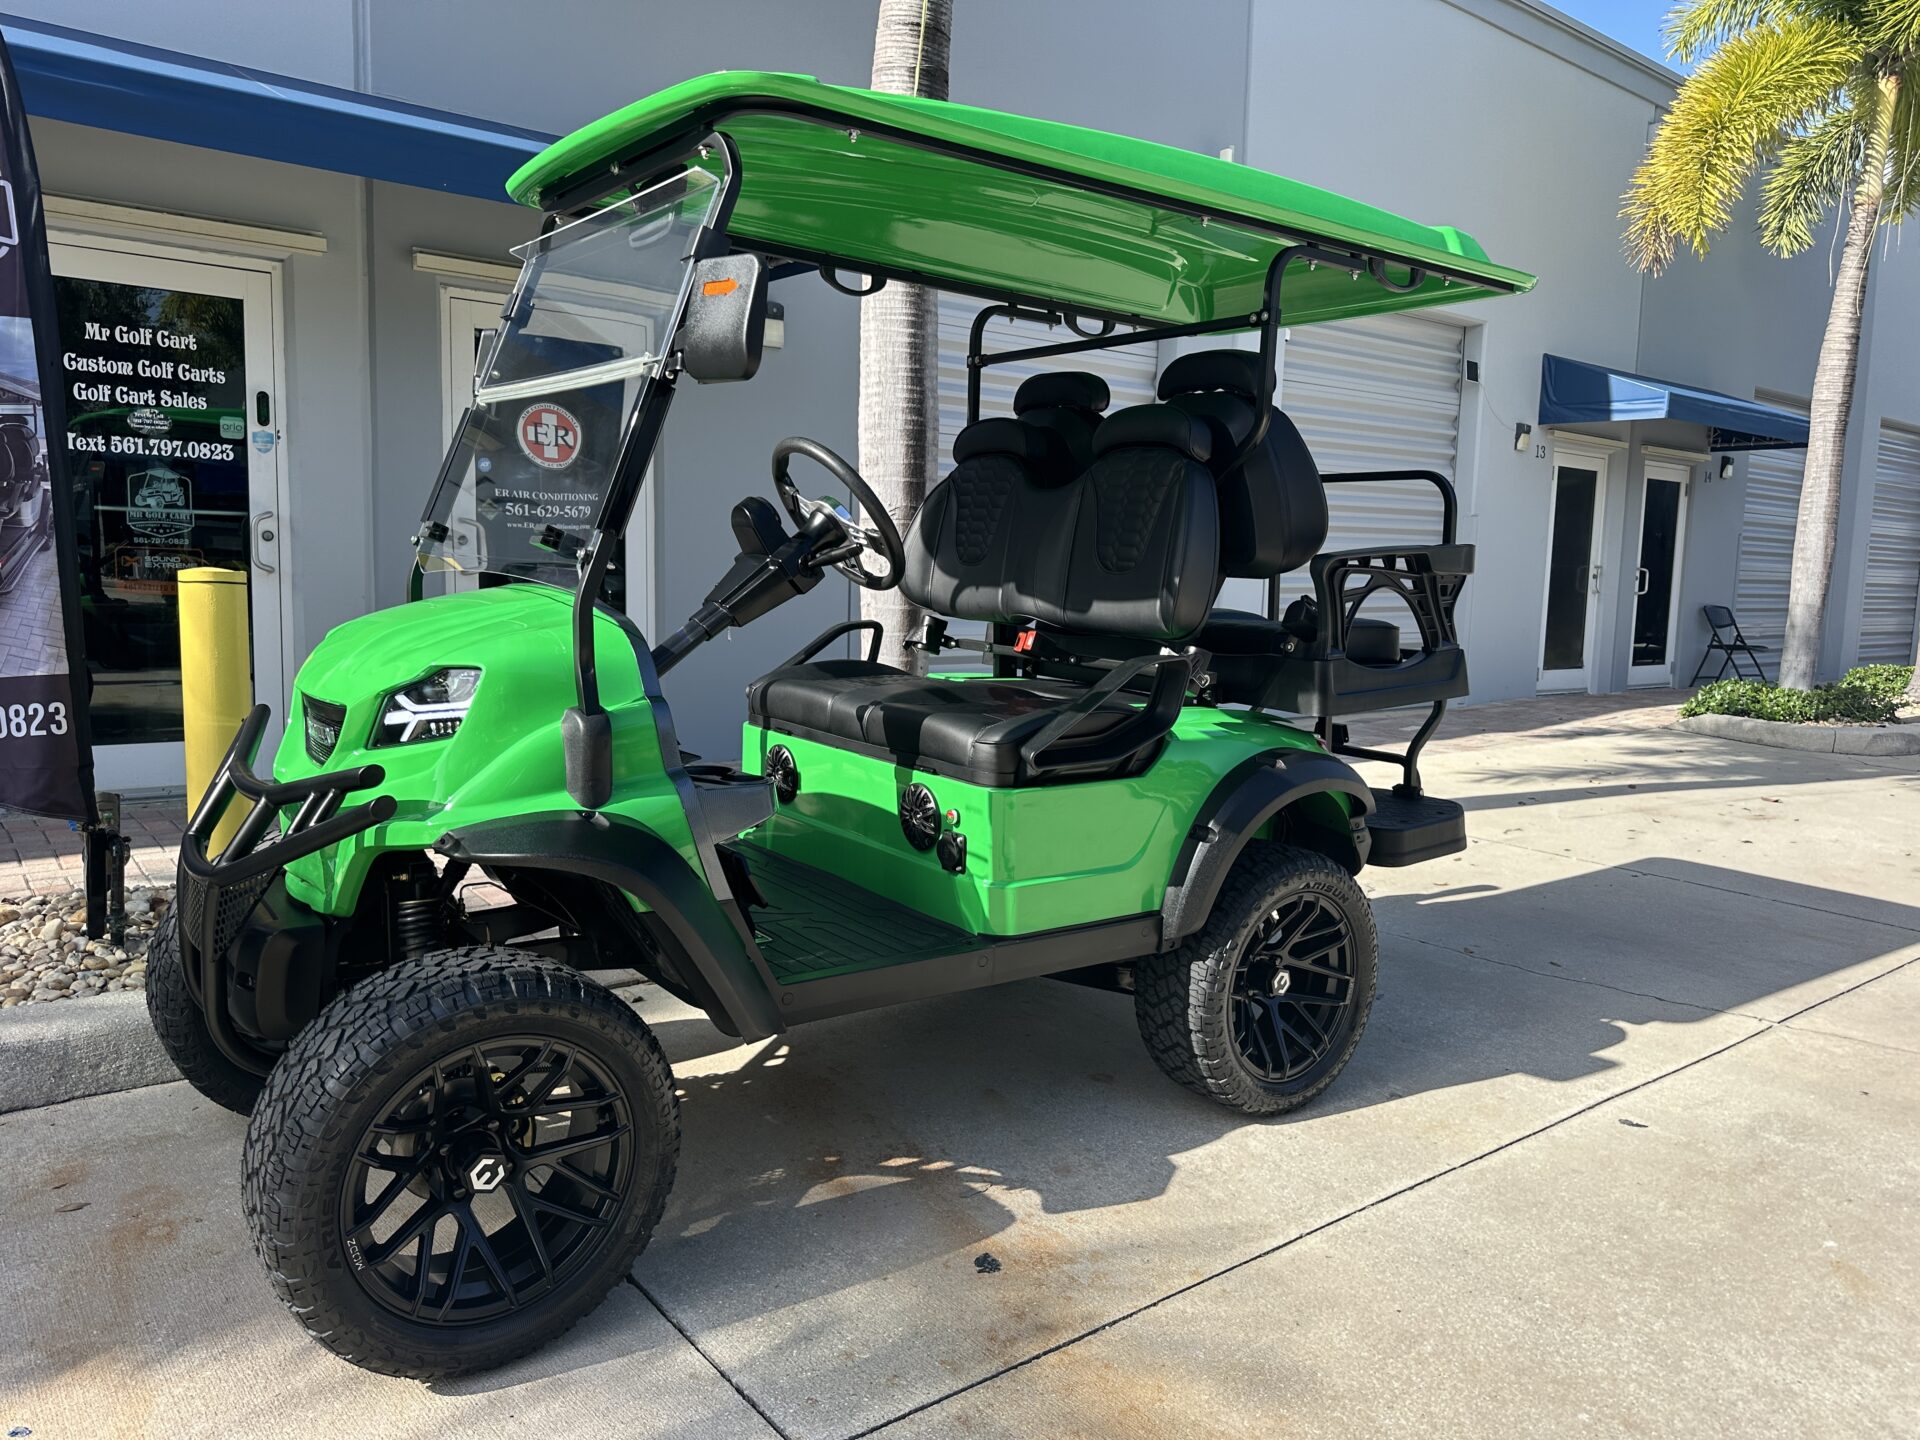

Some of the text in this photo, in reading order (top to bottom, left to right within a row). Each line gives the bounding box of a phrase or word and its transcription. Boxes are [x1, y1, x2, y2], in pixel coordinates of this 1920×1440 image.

[84, 321, 198, 350] Mr Golf Cart
[63, 352, 226, 384] Custom Golf Carts
[73, 382, 208, 410] Golf Cart Sales
[222, 422, 243, 432] arlo
[533, 423, 575, 449] ER
[110, 436, 235, 461] 561.797.0823
[1535, 444, 1546, 459] 13
[1704, 471, 1712, 483] 14
[494, 488, 599, 501] ER AIR CONDITIONING
[145, 511, 167, 519] GOLF
[170, 512, 191, 520] CART
[505, 502, 591, 518] 561-629-5679
[144, 555, 181, 563] SOUND
[1301, 881, 1349, 904] ARISUN
